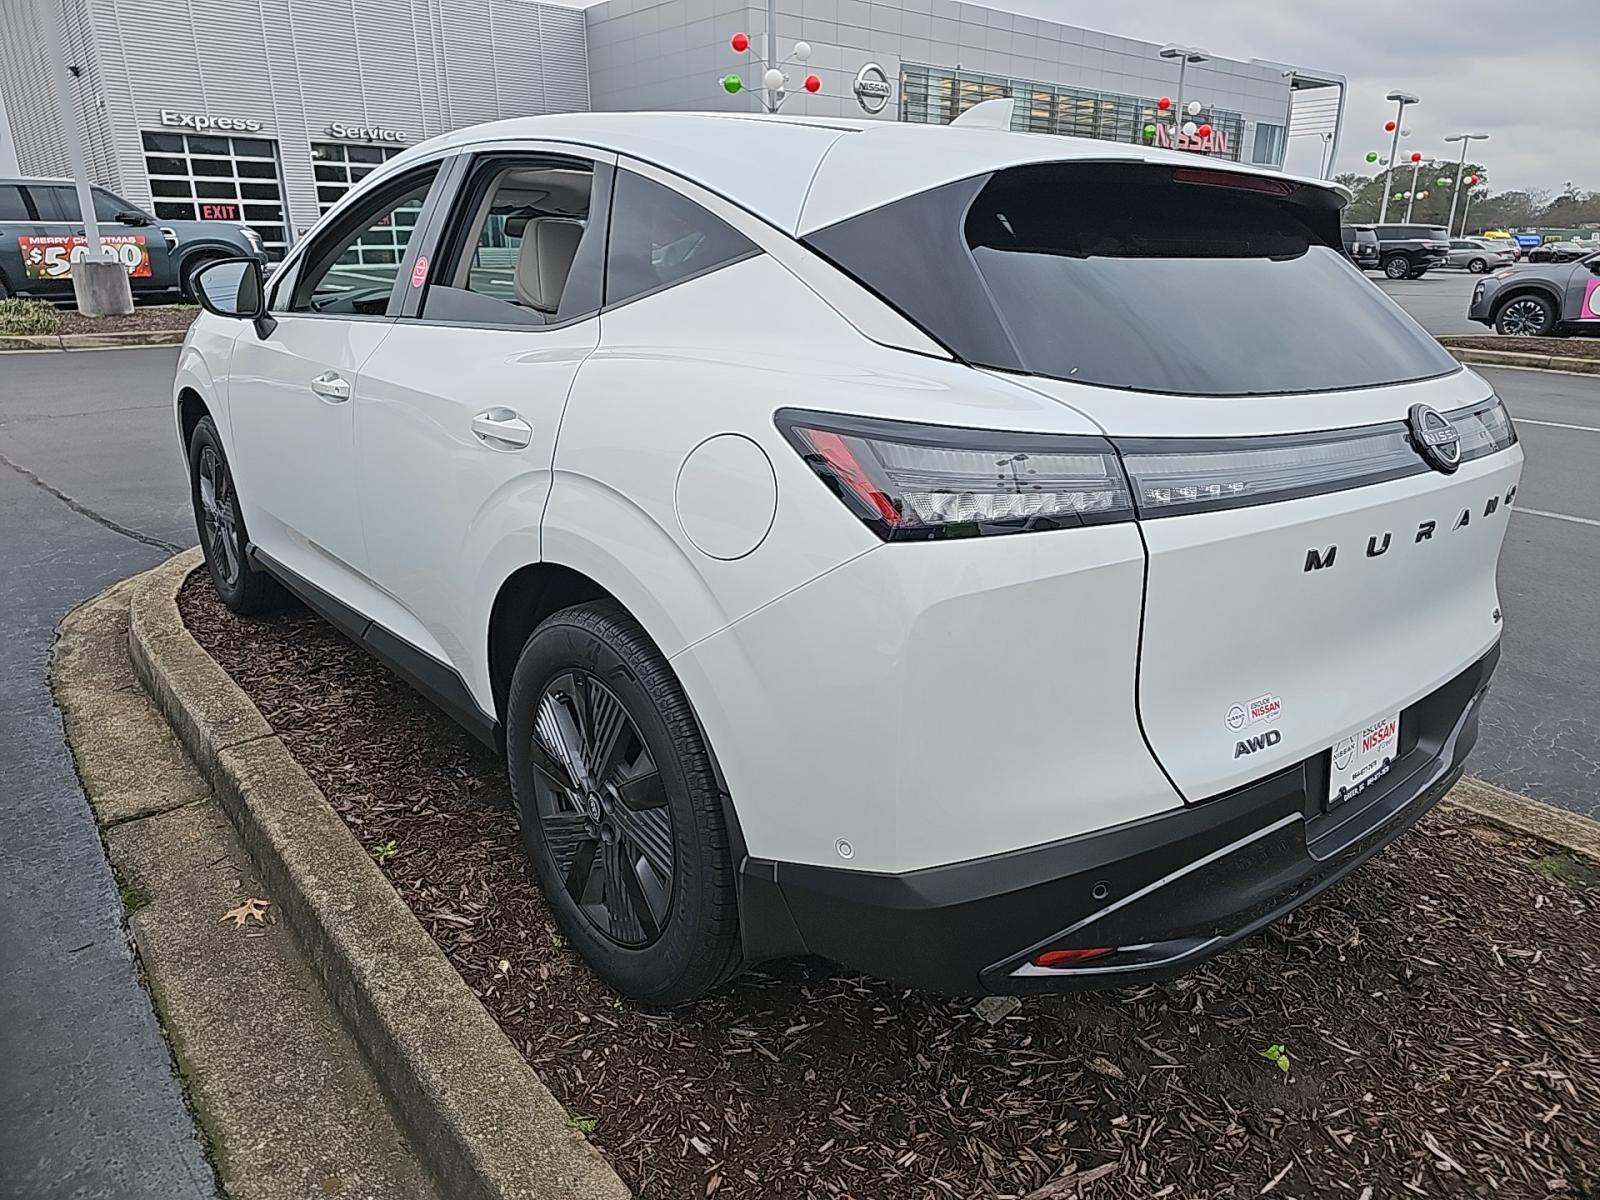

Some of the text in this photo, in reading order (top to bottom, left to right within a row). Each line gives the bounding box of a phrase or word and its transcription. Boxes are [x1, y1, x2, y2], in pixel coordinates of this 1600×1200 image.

[858, 82, 889, 94] NISSAN
[160, 109, 261, 131] Express
[331, 122, 407, 142] Service
[203, 204, 236, 220] EXIT
[29, 236, 137, 245] MERRY CHSTMAS
[1251, 700, 1281, 718] NISSAN
[1234, 729, 1281, 759] AWD
[1361, 720, 1397, 754] NISSAN
